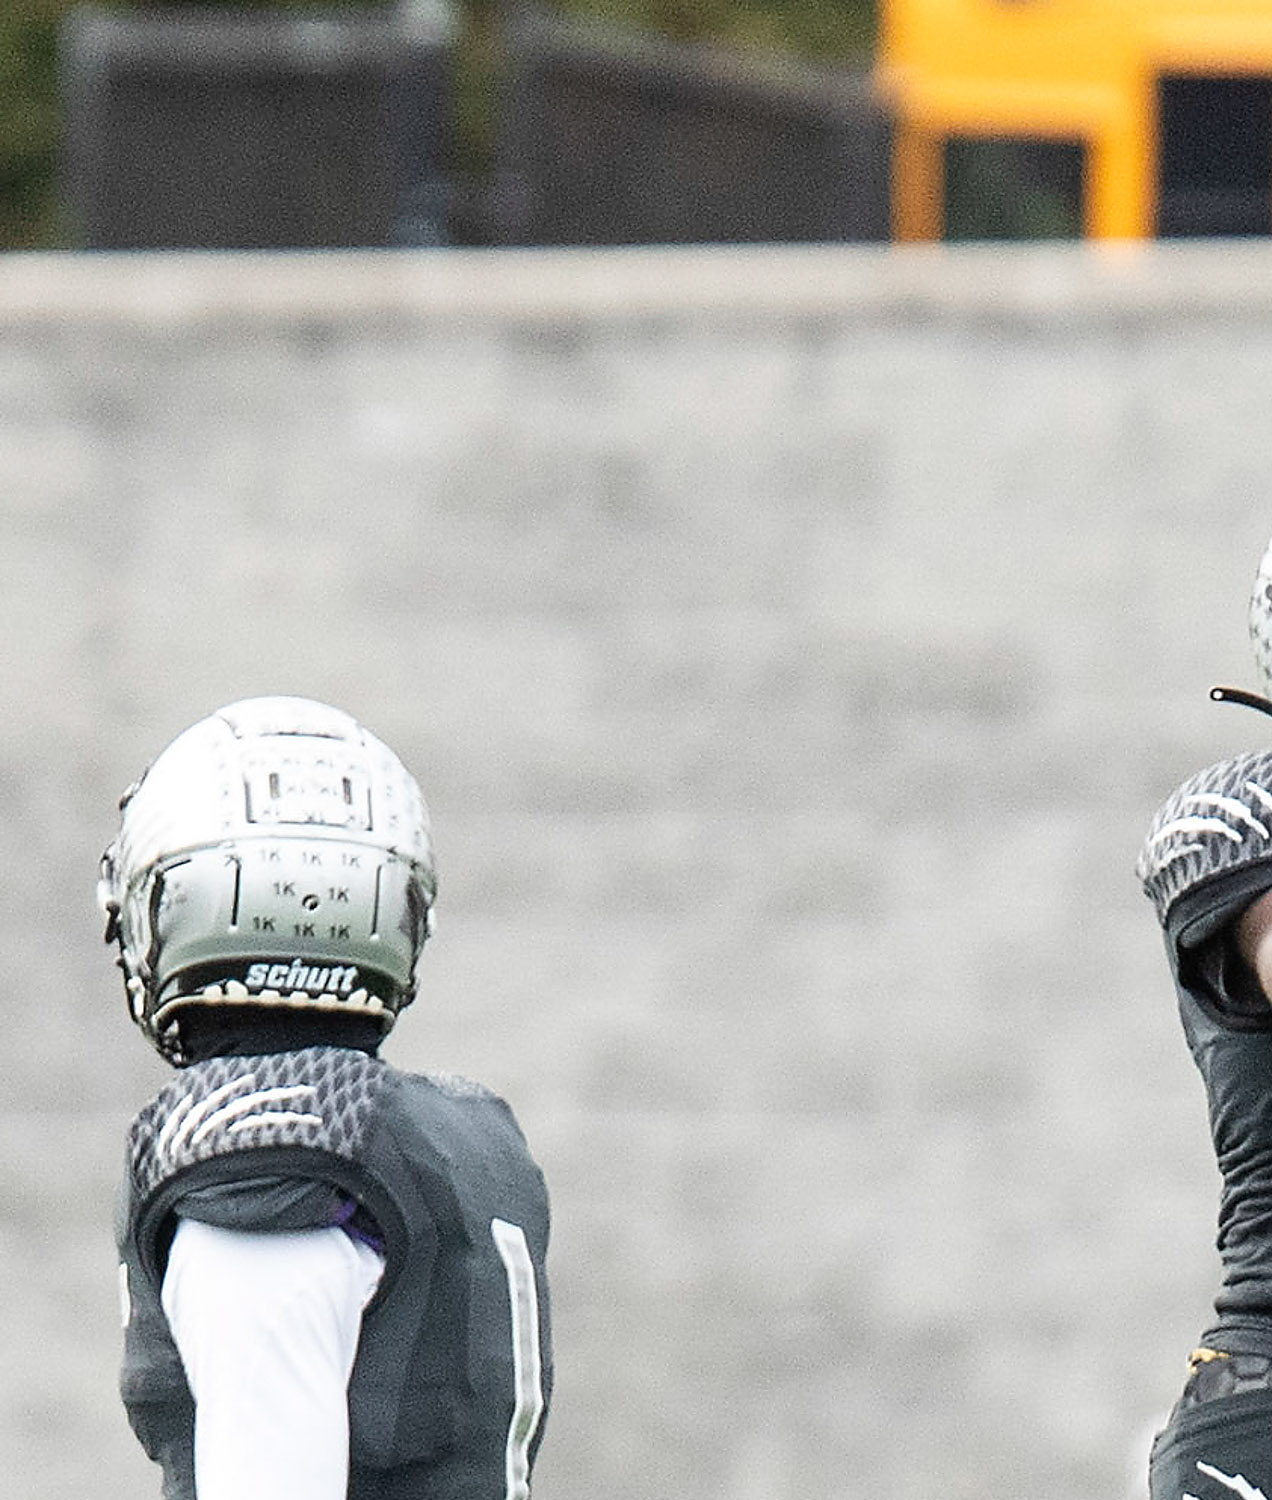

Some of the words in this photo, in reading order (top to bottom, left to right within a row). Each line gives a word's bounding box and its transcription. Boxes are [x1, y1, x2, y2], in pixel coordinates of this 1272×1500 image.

[261, 848, 282, 863] 1K
[302, 850, 322, 866] 1K
[341, 852, 361, 869] 1K
[273, 881, 297, 897] 1K
[328, 886, 350, 903] 1K
[251, 915, 277, 933] 1K
[293, 922, 316, 938] 1K
[328, 924, 352, 941] 1K
[245, 957, 359, 992] schutt
